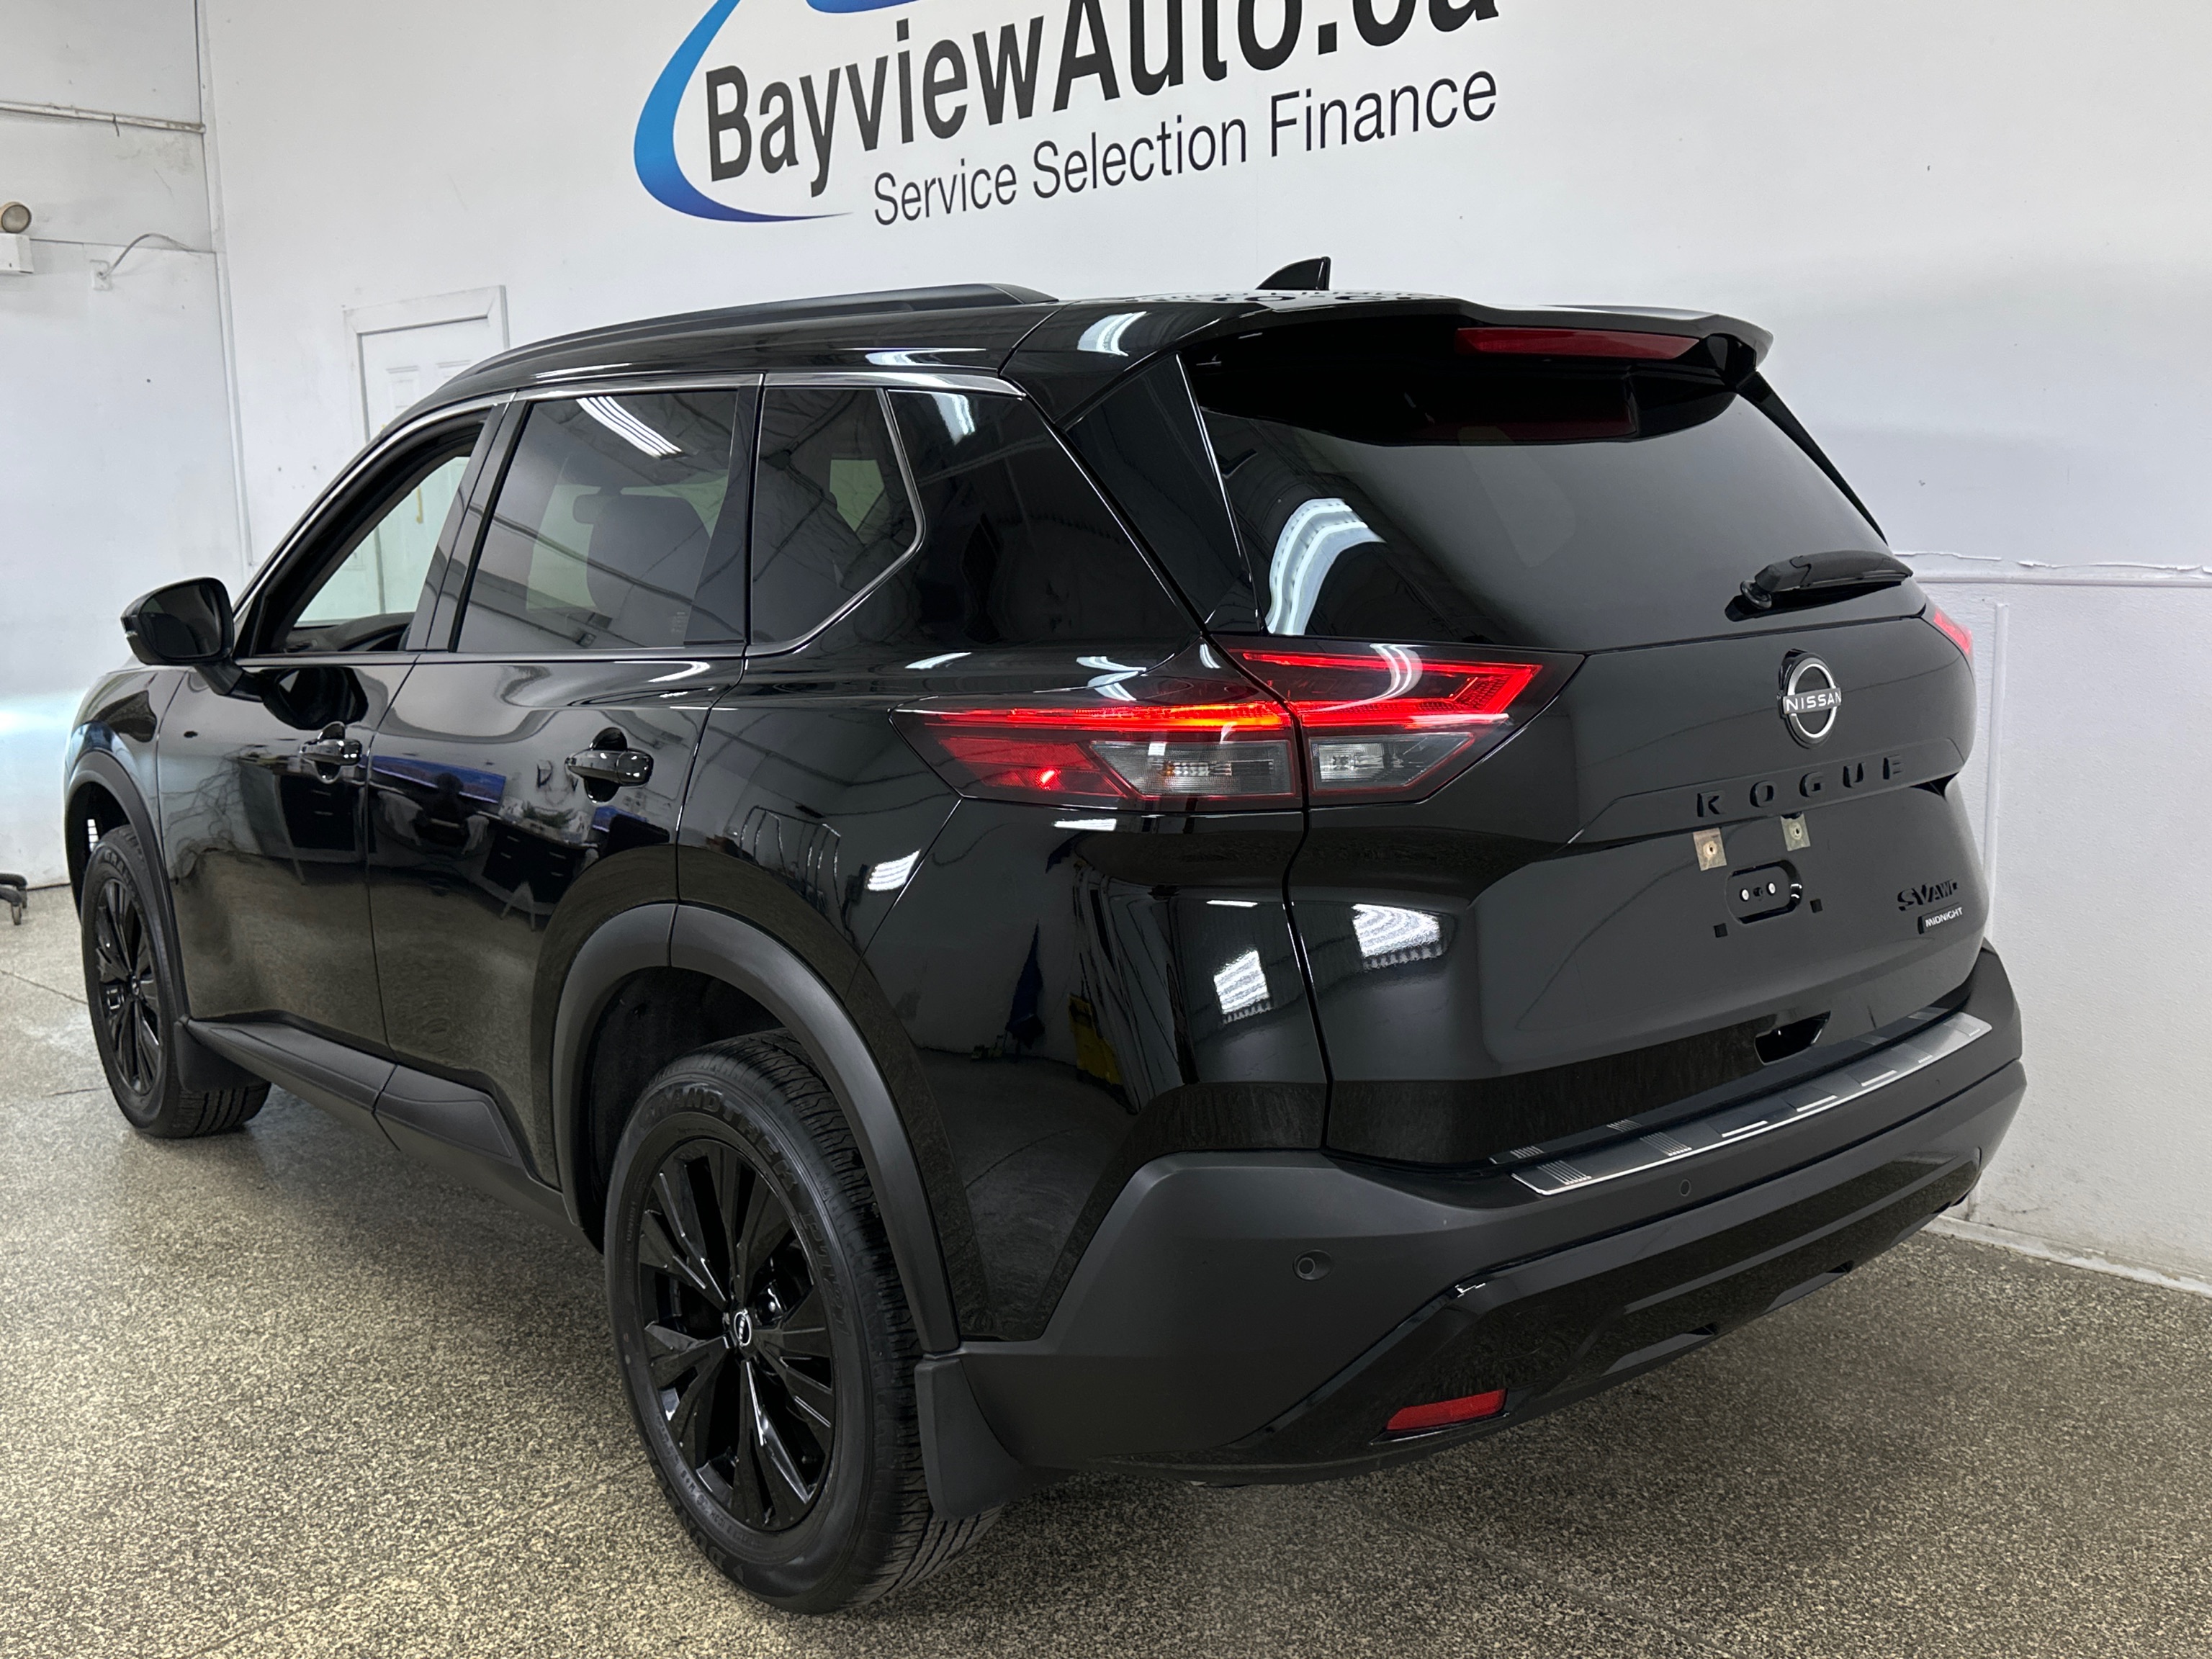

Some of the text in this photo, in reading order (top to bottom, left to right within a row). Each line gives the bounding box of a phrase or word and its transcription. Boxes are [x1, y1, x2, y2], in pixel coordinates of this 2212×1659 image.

[706, 0, 1498, 197] BayviewAuto.
[874, 71, 1496, 225] Service Selection Finance
[1786, 692, 1842, 711] NISSAN
[1696, 755, 1903, 817] ROGUE
[1925, 907, 1963, 927] MIDNIGHT
